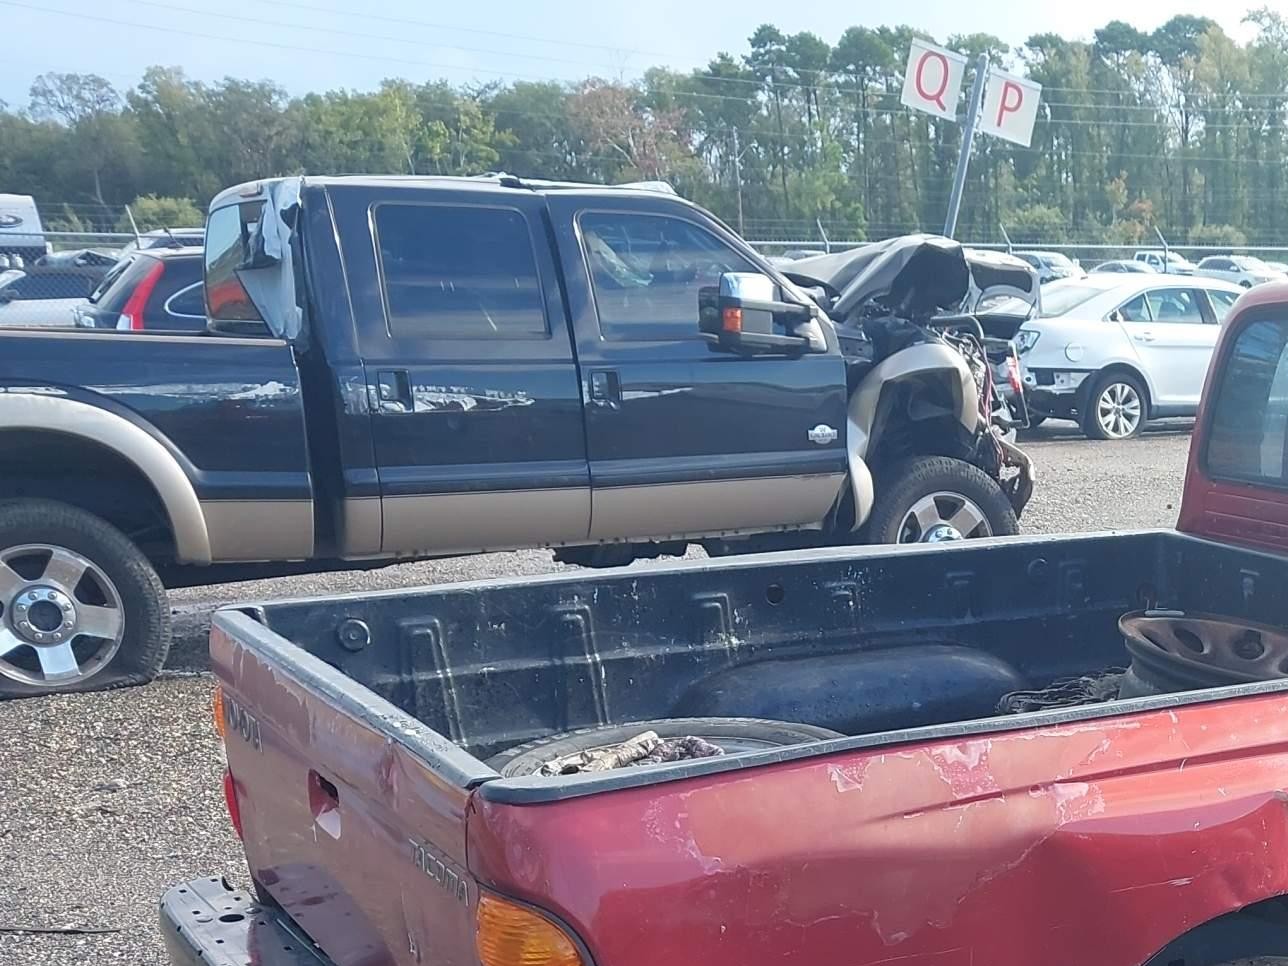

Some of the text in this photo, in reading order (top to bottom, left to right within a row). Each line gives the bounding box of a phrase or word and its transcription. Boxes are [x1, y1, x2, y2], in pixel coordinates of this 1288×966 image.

[915, 50, 949, 112] Q
[996, 80, 1024, 128] P
[409, 838, 469, 907] TACOMA
